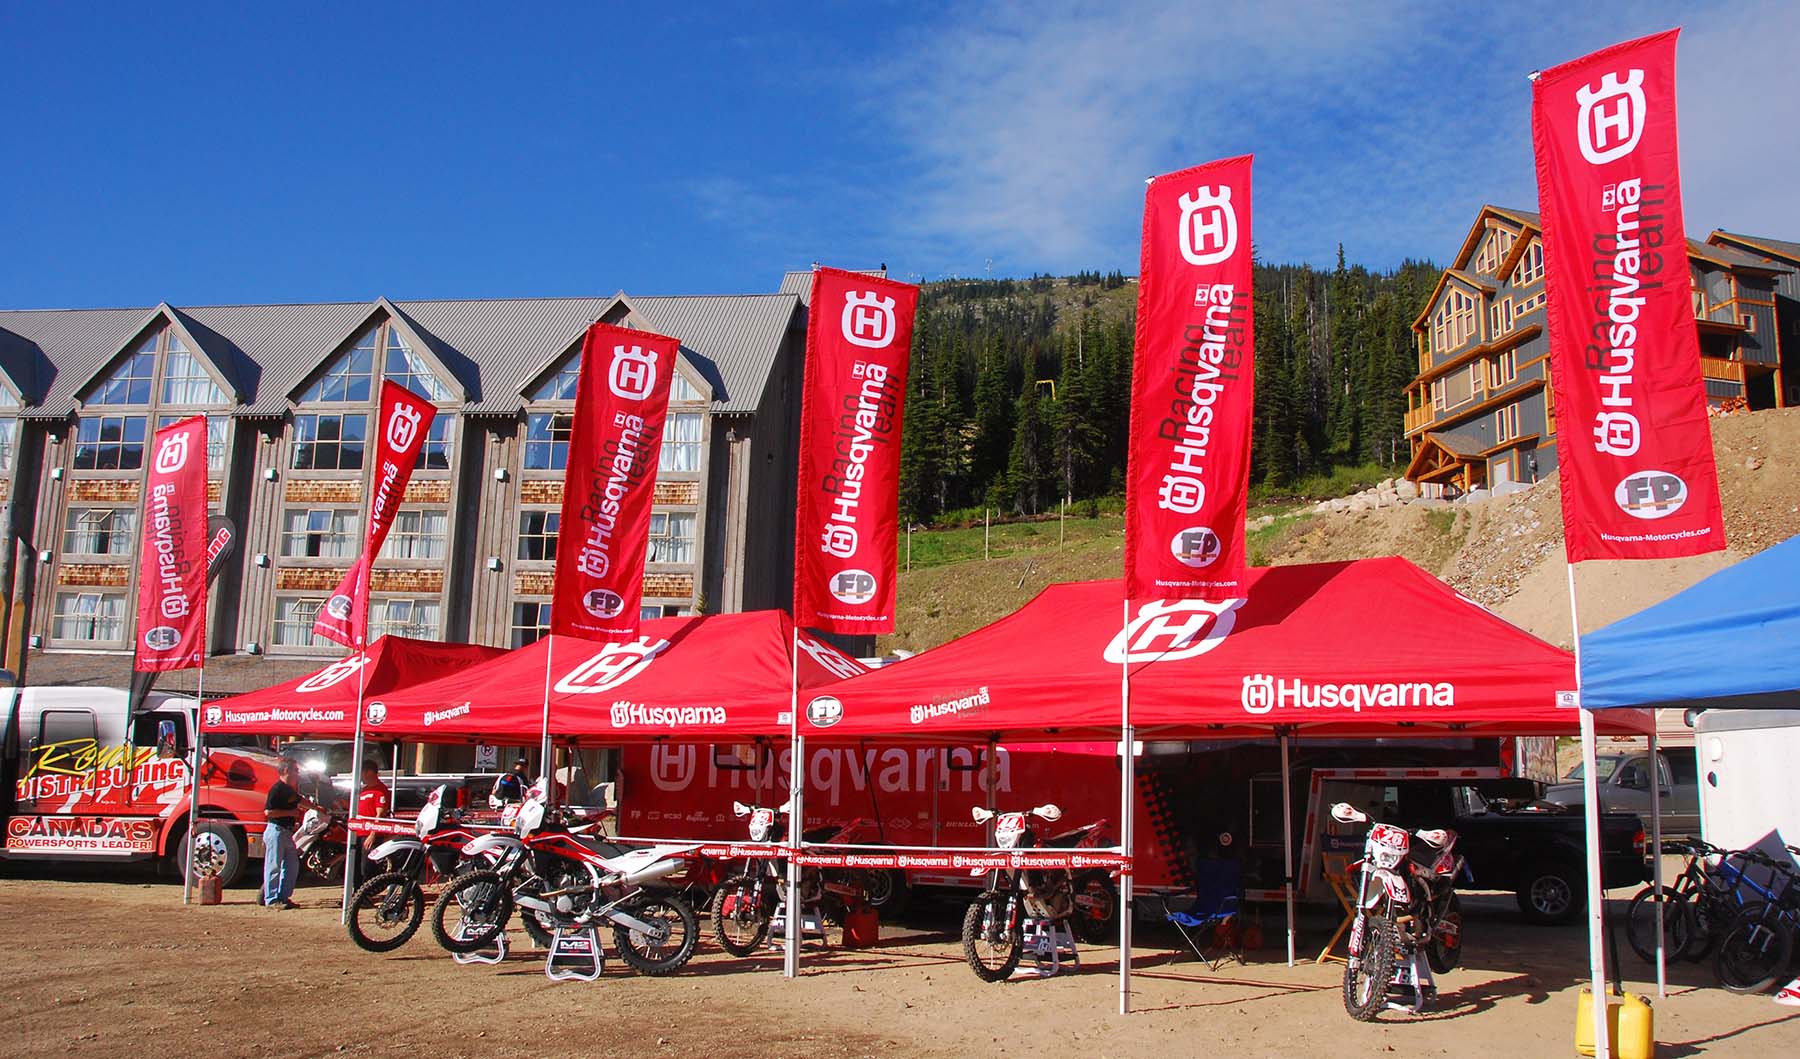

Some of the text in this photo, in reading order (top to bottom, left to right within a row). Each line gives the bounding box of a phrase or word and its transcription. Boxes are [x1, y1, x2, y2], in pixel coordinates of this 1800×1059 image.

[1600, 177, 1646, 407] Husqvarna
[1170, 283, 1234, 475] Husqvarna
[831, 363, 888, 523] Husqvarna
[588, 414, 644, 551] Husqvarna
[924, 693, 990, 720] Husqvarna
[1278, 678, 1455, 712] Husqvarna
[225, 708, 344, 724] Husqvarna-Motorcycles.com
[431, 703, 470, 723] Husqvarna
[631, 704, 726, 728] Husqvarna
[16, 759, 184, 802] DISTRIBUTING
[708, 744, 1012, 807] Husqvarna
[9, 818, 153, 838] CANADA'S
[1382, 829, 1404, 845] 26
[8, 838, 152, 849] POWERSPORTS LEADER!
[854, 857, 894, 867] Husqvarna
[907, 857, 948, 867] Husqvarna
[963, 857, 1005, 868] Husqvarna
[1020, 857, 1066, 868] Husqvarna
